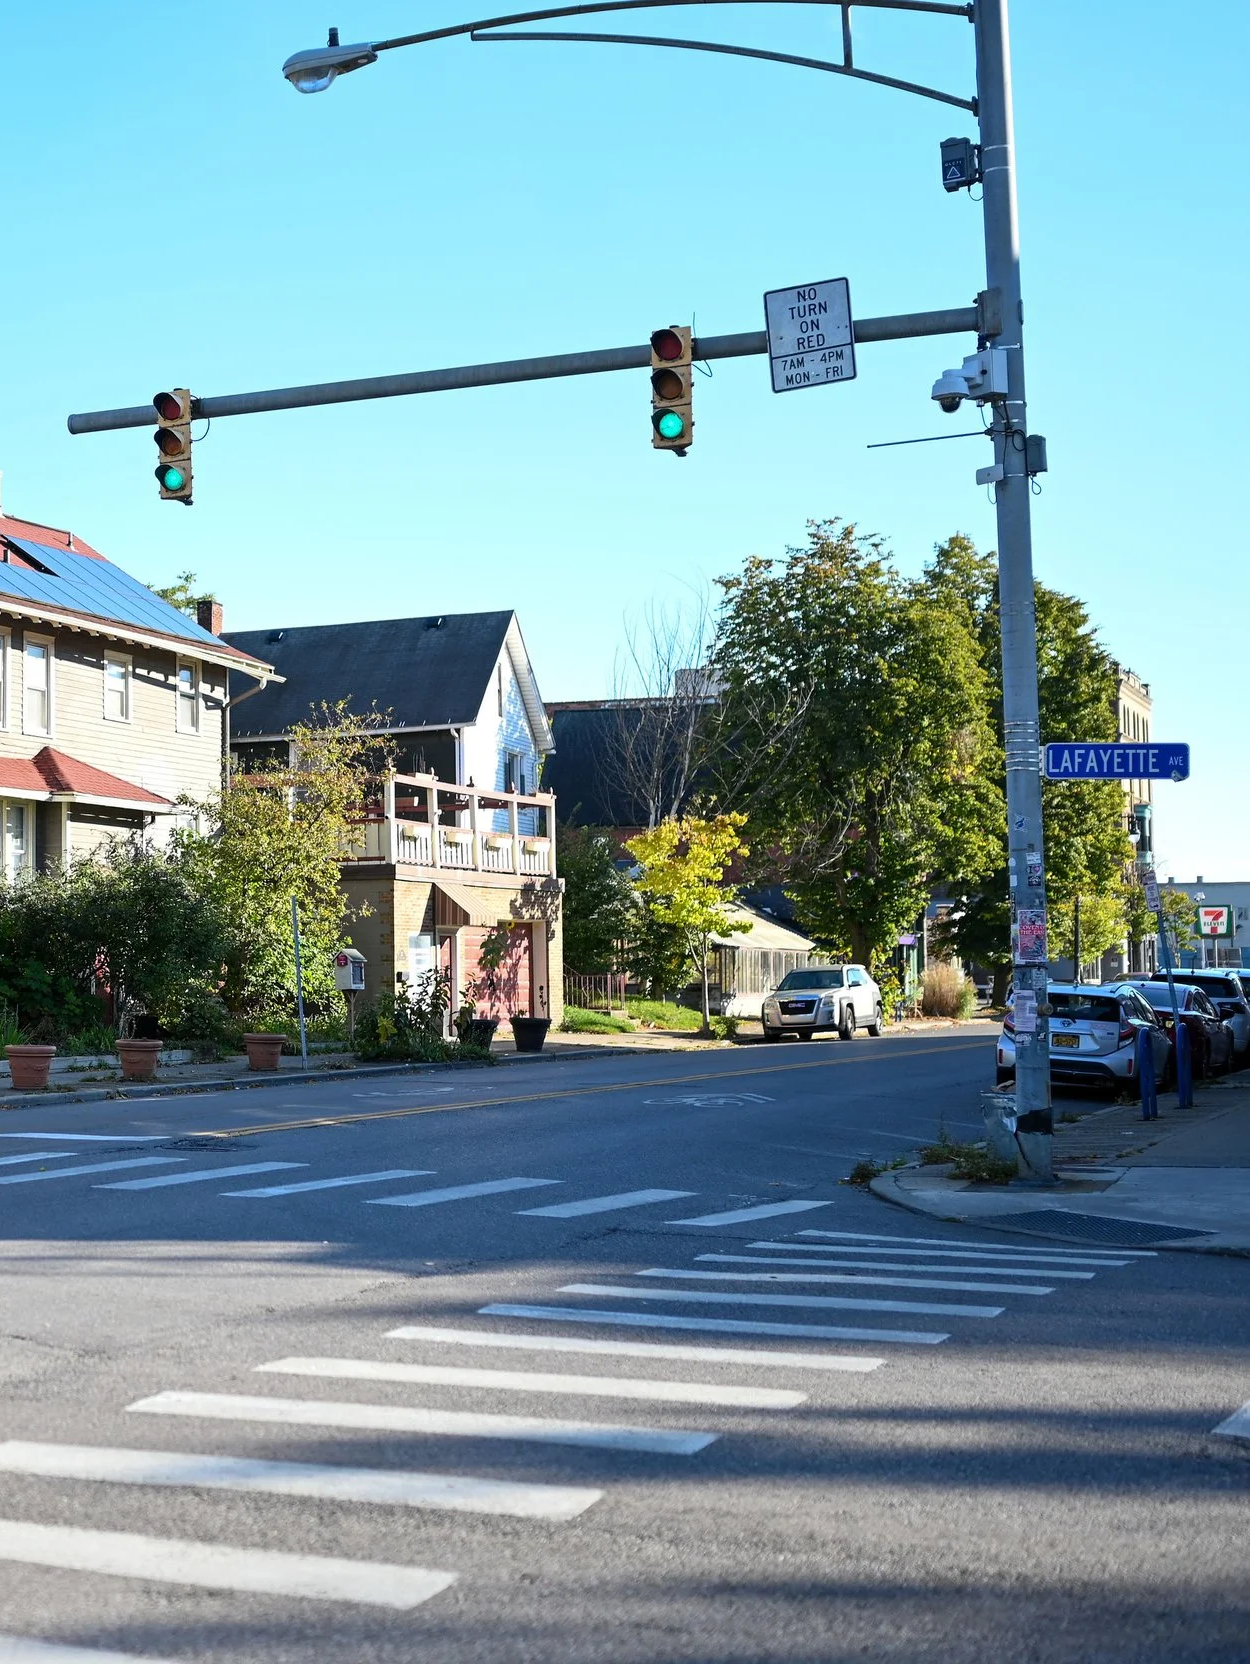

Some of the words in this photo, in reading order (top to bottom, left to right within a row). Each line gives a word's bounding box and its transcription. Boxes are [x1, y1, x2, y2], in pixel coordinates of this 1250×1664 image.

[797, 287, 817, 303] NO
[788, 301, 828, 320] TURN
[800, 319, 820, 334] ON
[796, 333, 826, 351] RED
[781, 356, 805, 372] 7AM
[819, 349, 844, 364] 4PM
[785, 371, 810, 386] MON
[825, 365, 844, 379] FRI
[1049, 749, 1160, 773] LAFAYETTE
[1168, 756, 1184, 766] AVE
